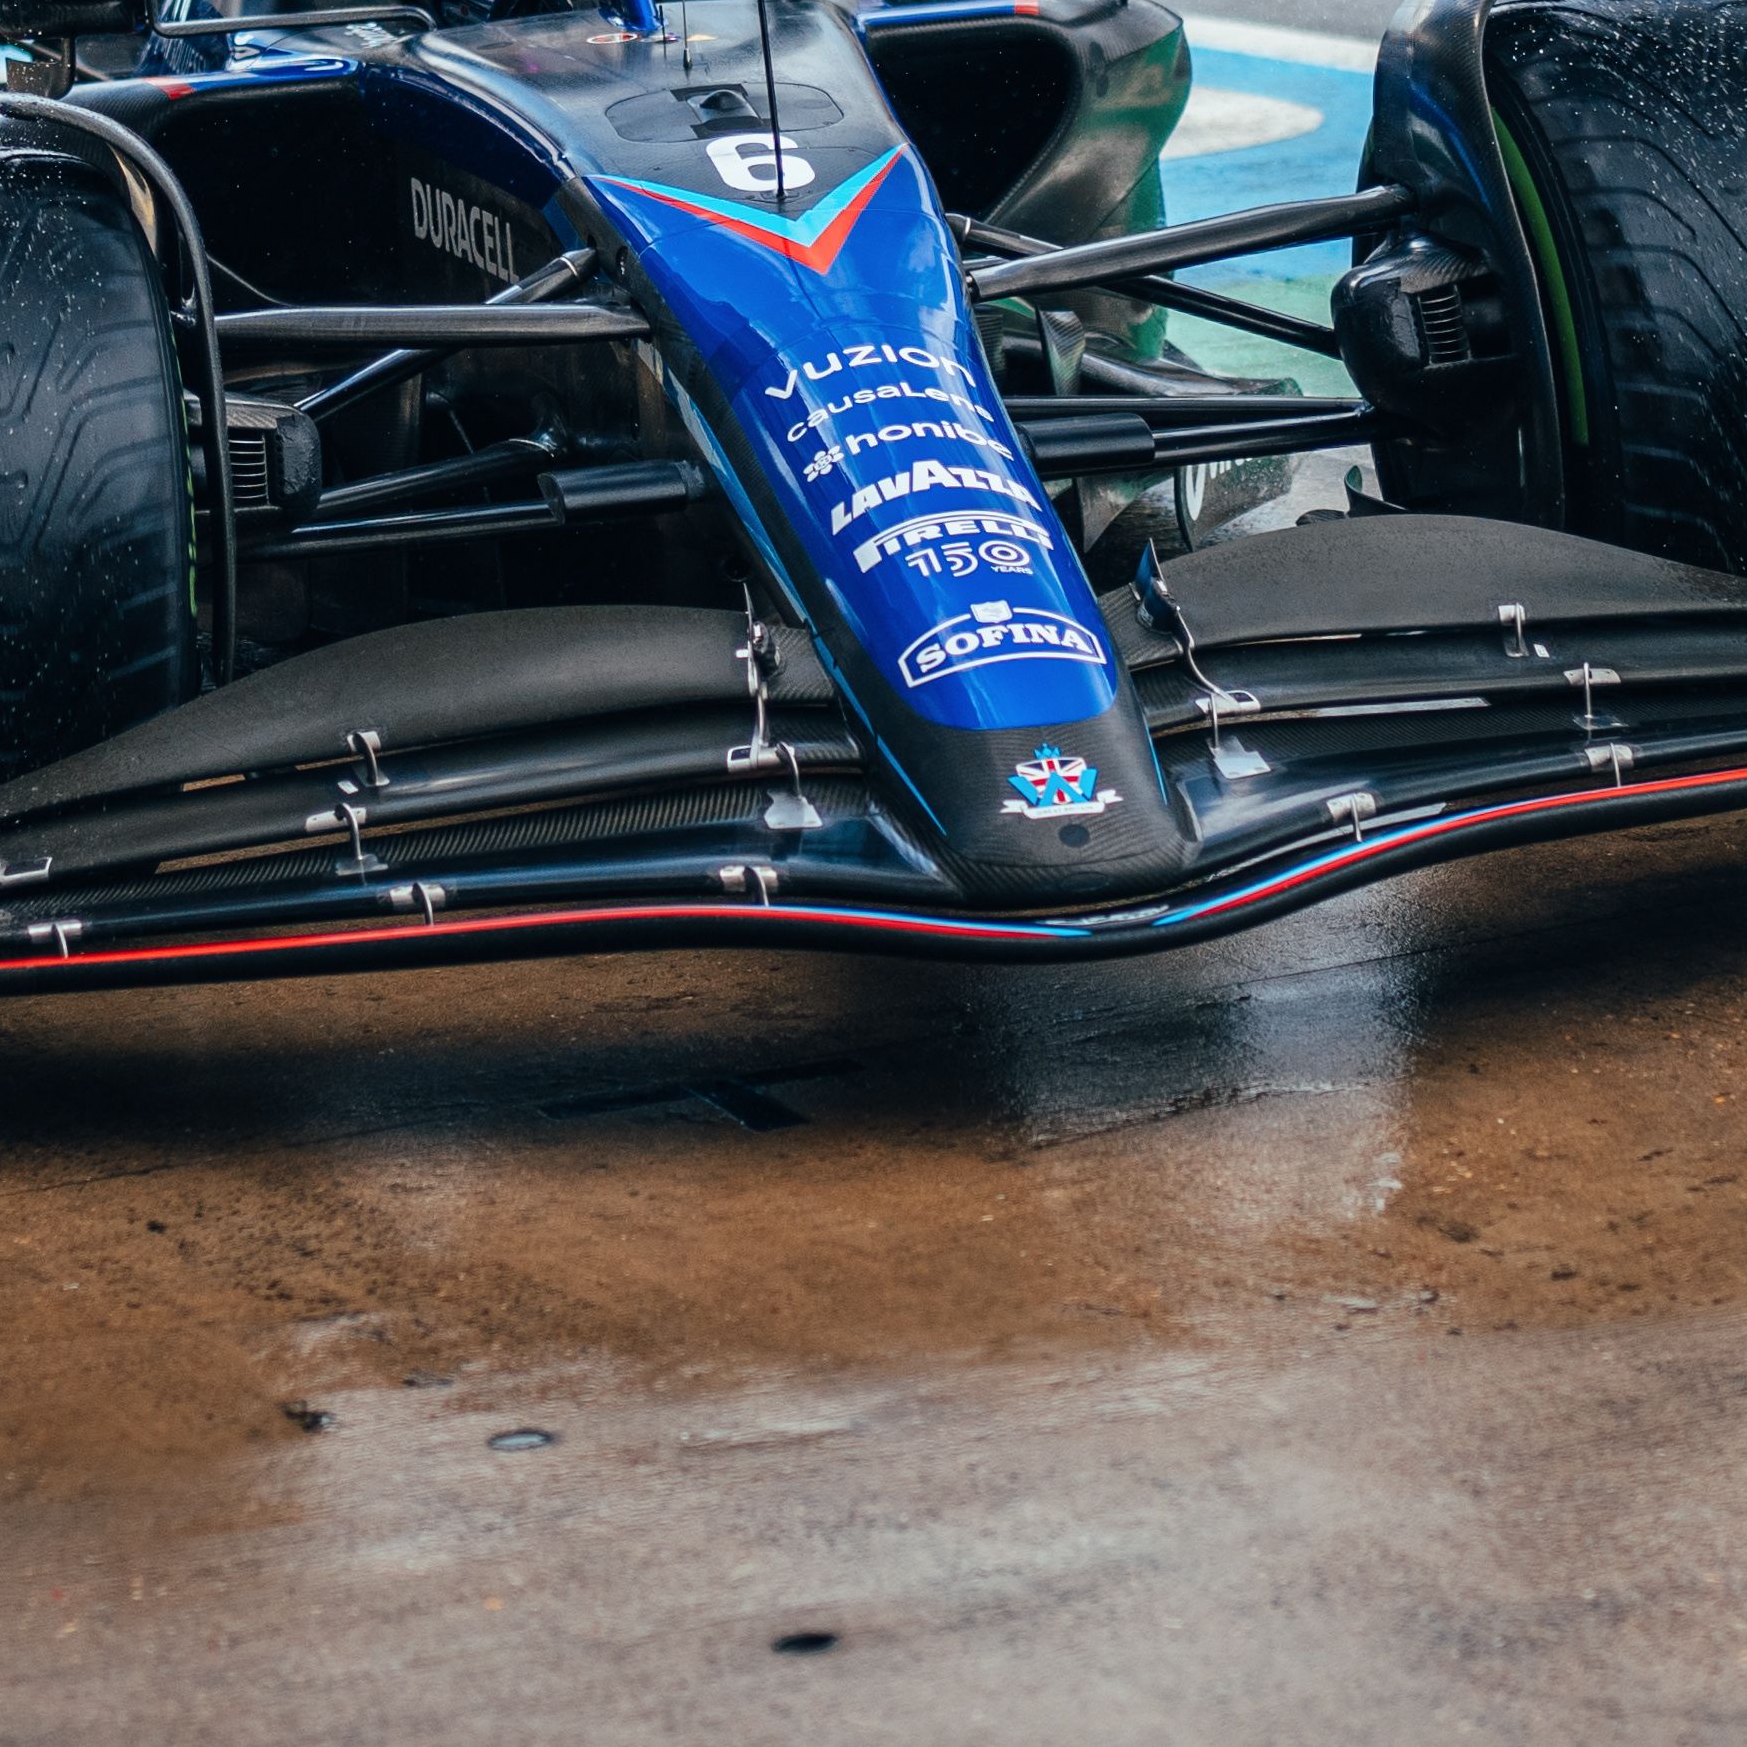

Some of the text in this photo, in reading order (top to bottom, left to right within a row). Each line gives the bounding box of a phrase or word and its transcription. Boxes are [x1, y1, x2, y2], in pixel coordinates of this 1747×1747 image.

[705, 133, 816, 192] 6
[410, 177, 521, 284] DURACELL
[845, 420, 1015, 462] honibe
[831, 460, 1043, 536] LAVAZZA
[852, 510, 1055, 574] PIRELLI
[904, 540, 1031, 578] 150
[990, 565, 1034, 576] YEARS
[916, 623, 1094, 674] SOFINA
